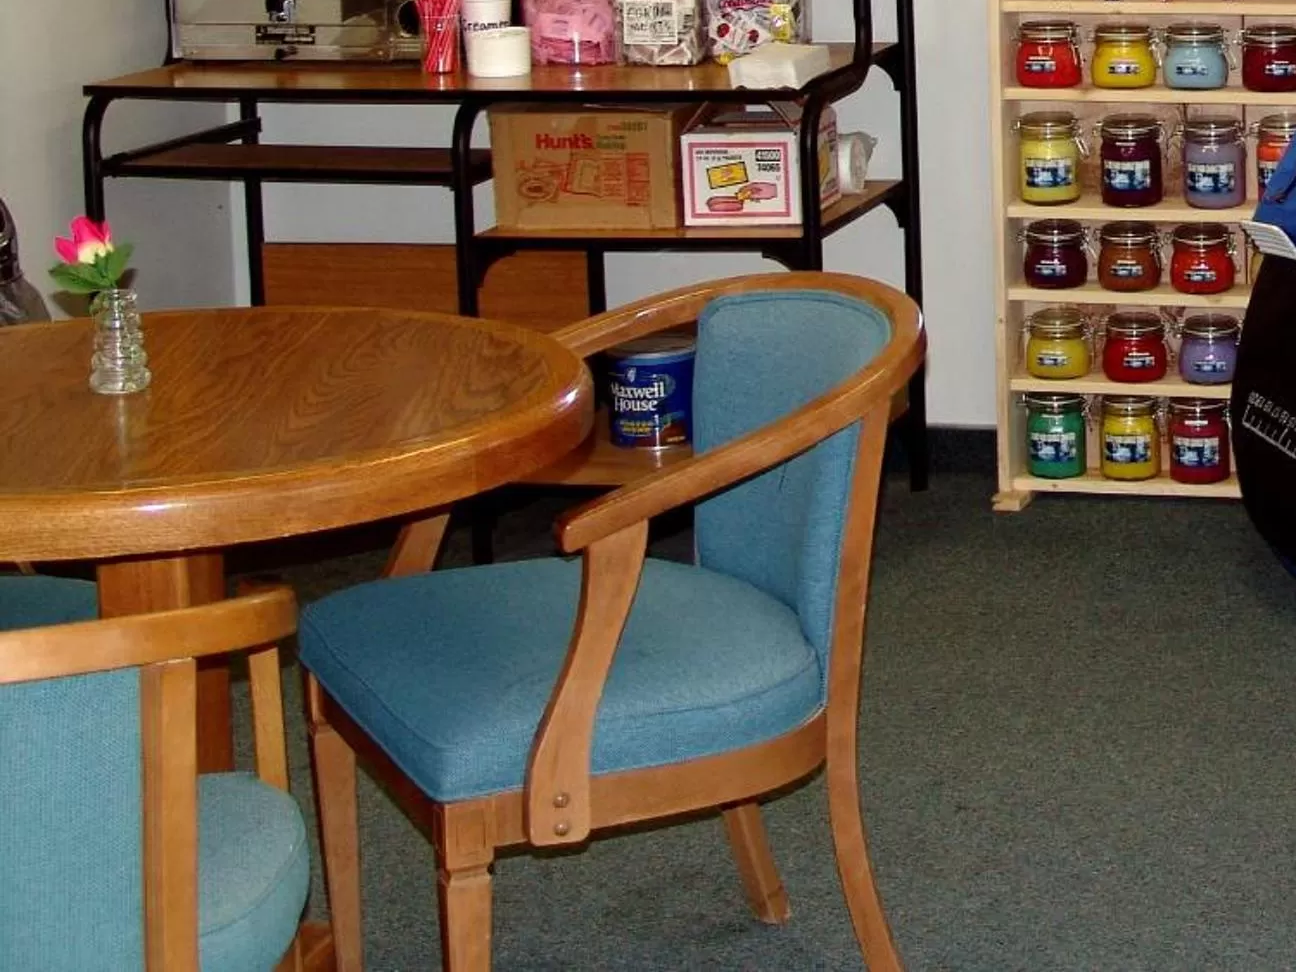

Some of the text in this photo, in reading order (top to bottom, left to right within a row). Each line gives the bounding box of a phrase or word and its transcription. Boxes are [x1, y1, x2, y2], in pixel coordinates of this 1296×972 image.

[535, 133, 593, 149] Hunt's
[611, 381, 665, 399] Maxwell
[614, 397, 658, 412] House
